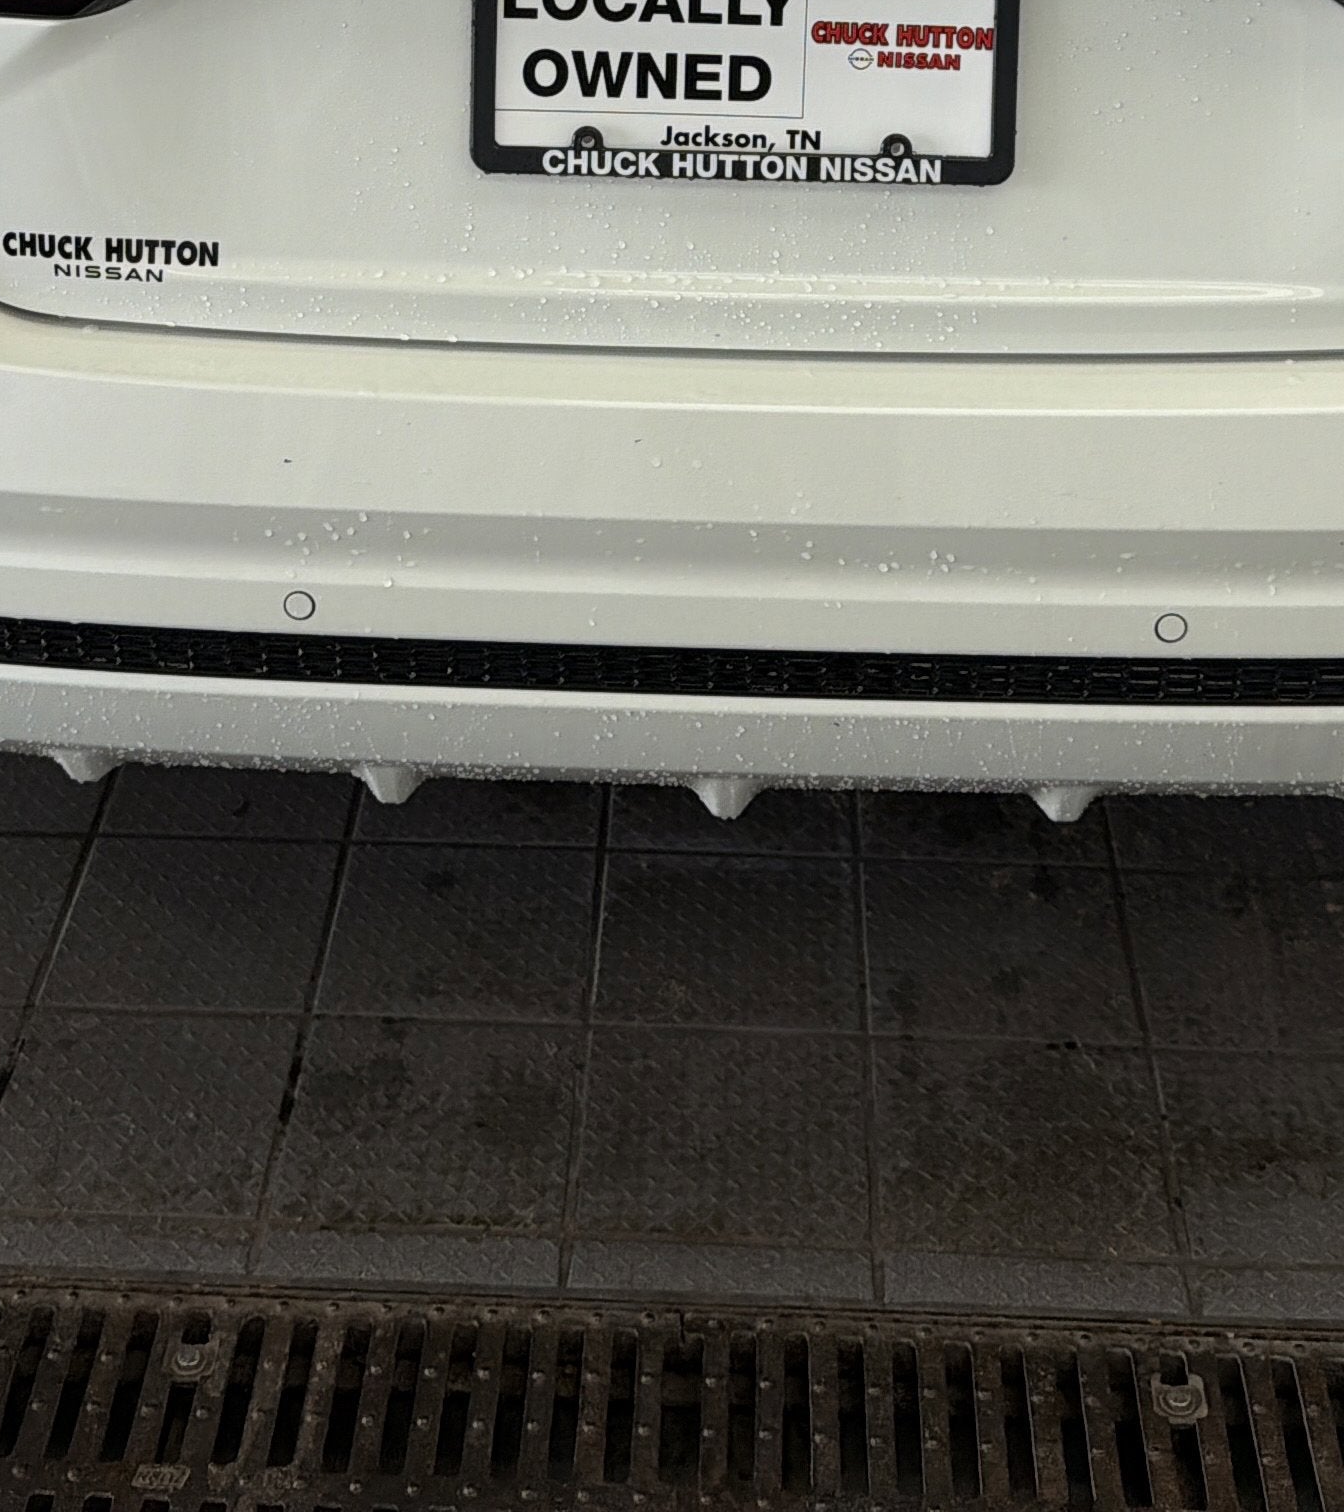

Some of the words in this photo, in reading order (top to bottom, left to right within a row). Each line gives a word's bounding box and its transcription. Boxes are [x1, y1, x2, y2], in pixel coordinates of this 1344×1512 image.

[811, 20, 890, 46] CHUCK
[896, 24, 995, 51] HUTTON
[522, 48, 772, 102] OWNED
[877, 51, 962, 71] NISSAN
[660, 125, 775, 153] Jackson,
[786, 129, 822, 150] TN
[542, 149, 660, 177] CHUCK
[672, 152, 807, 180] HUTTON
[820, 156, 942, 184] NISSAN
[2, 231, 94, 262] CHUCK
[105, 237, 220, 267] HUTTON
[54, 263, 164, 283] NISSAN
